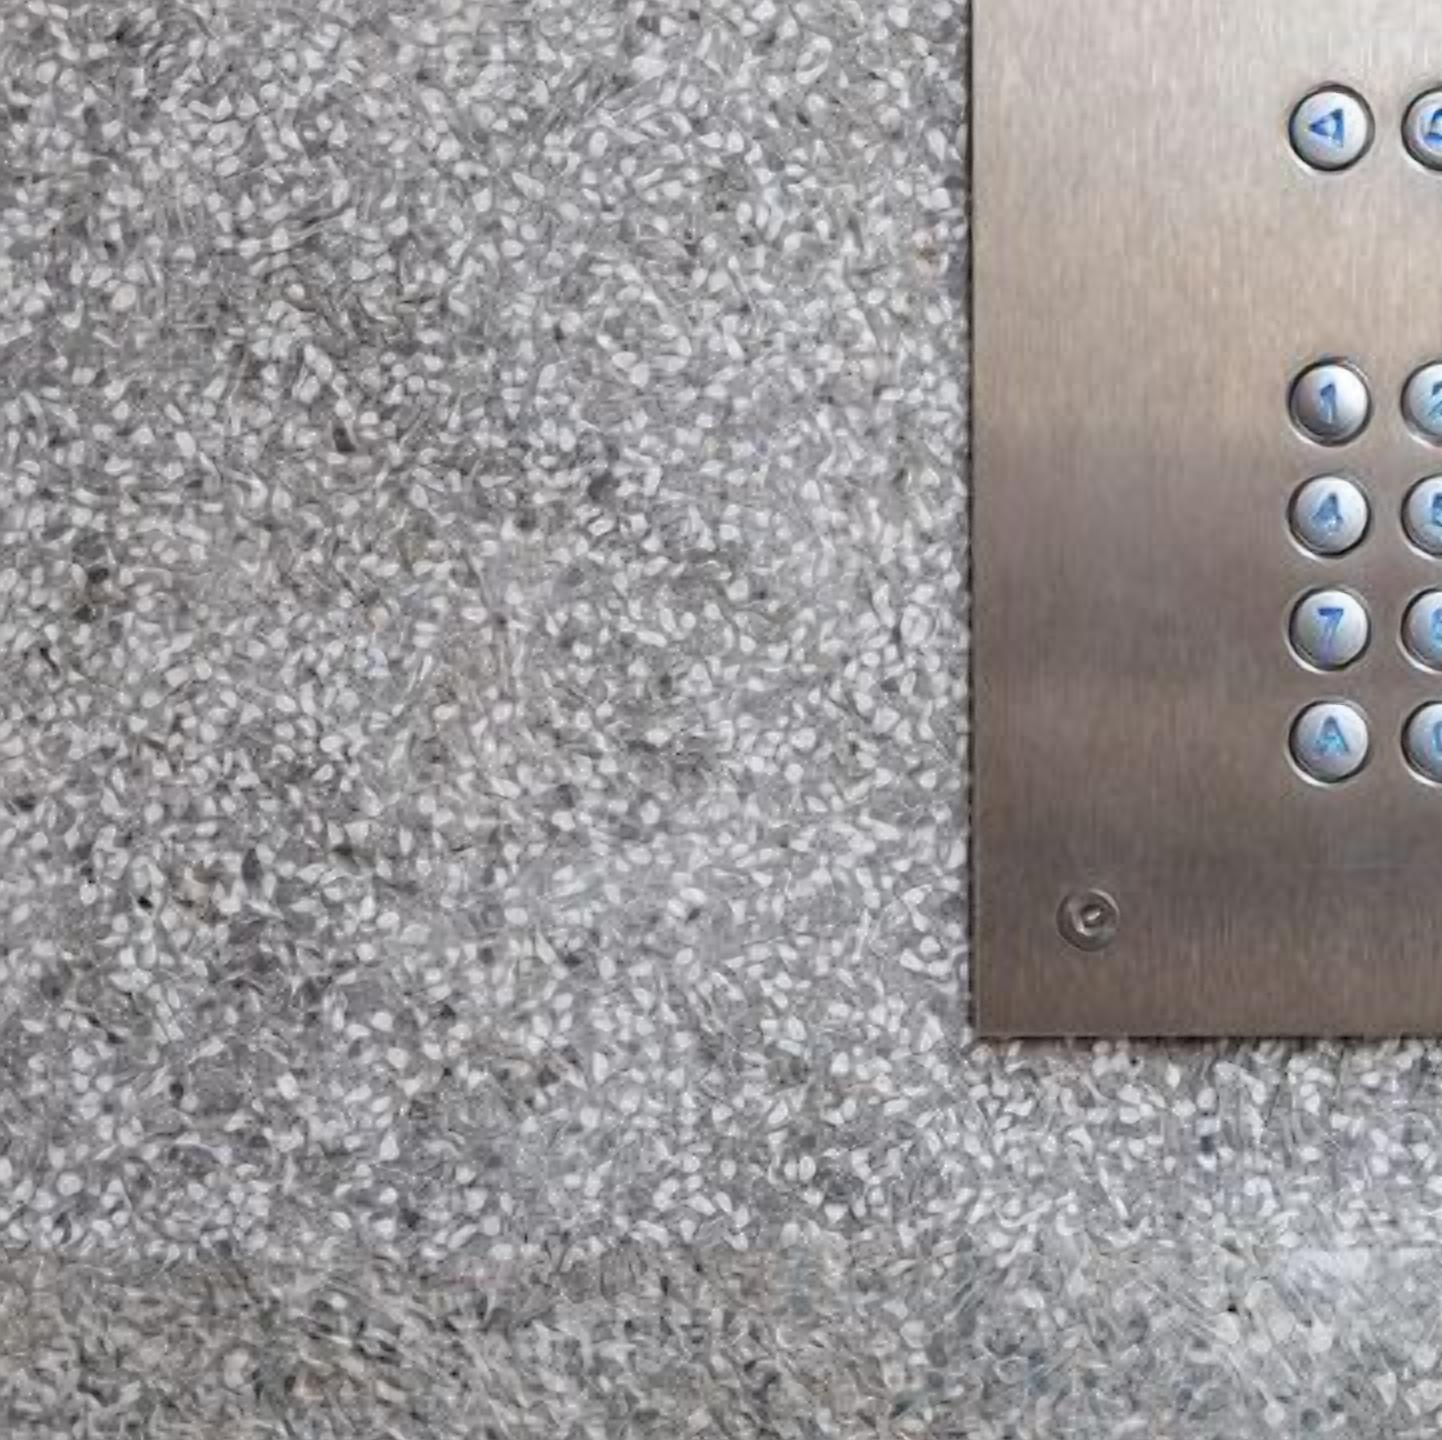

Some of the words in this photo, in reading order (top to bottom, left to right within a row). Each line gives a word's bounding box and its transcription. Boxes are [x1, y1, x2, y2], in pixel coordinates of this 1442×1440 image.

[1319, 383, 1338, 425] 1
[1312, 492, 1346, 533] 4
[1317, 607, 1345, 650] 7
[1314, 714, 1350, 757] A
